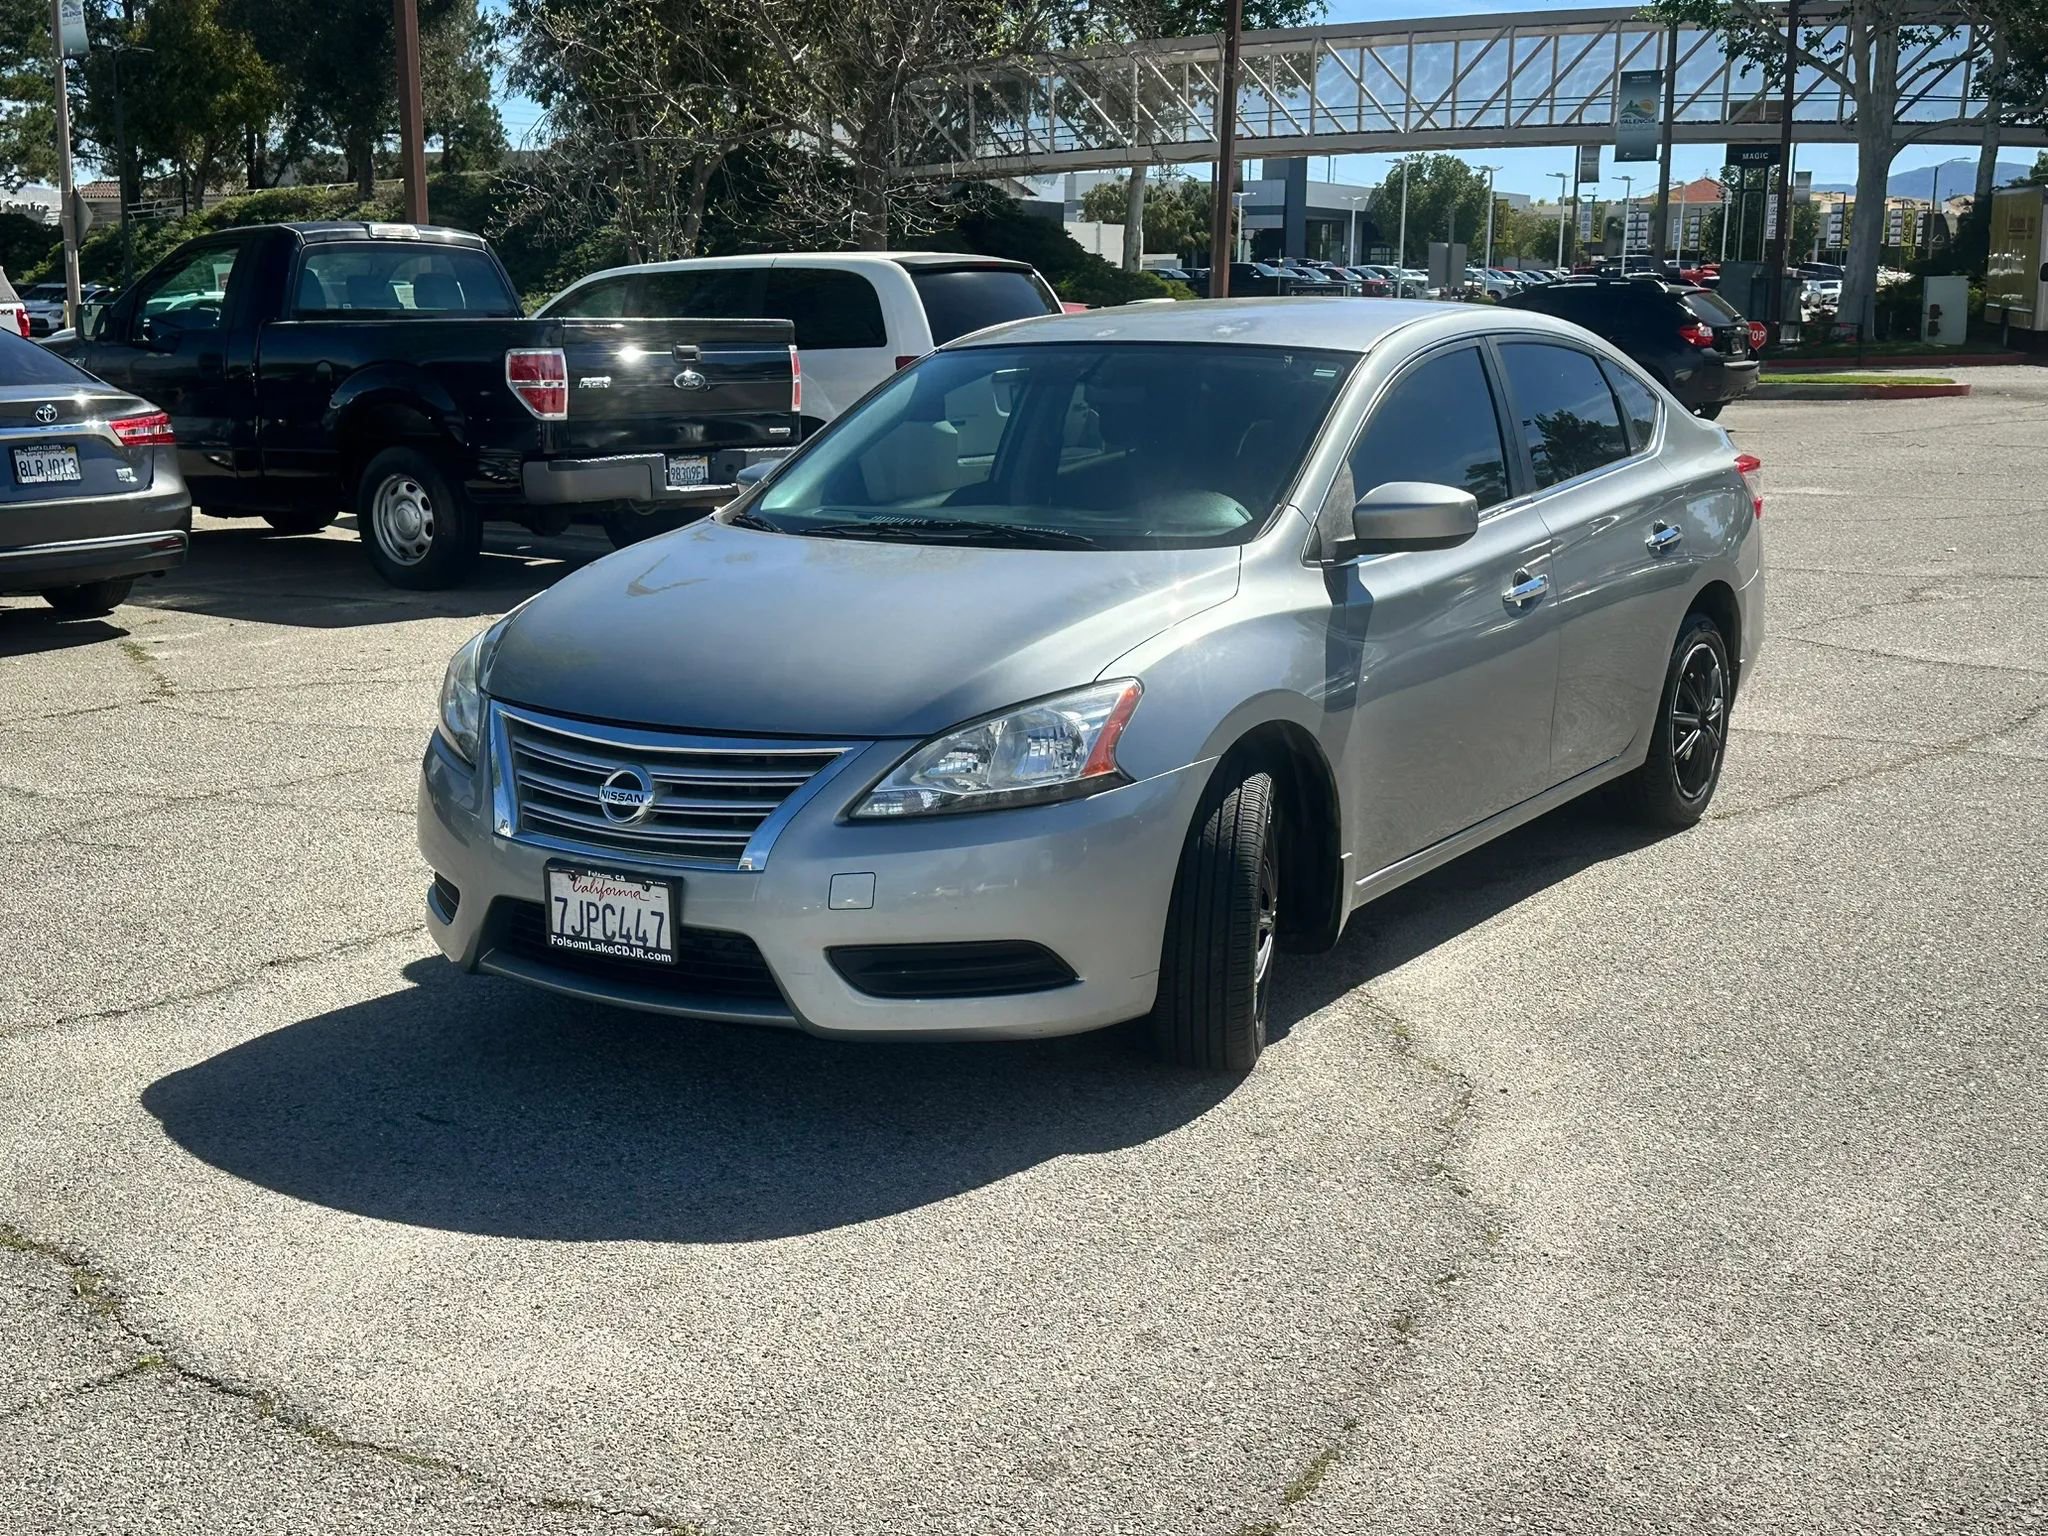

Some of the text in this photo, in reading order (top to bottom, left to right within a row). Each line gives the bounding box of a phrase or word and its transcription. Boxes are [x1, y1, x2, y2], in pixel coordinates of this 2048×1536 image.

[1742, 152, 1769, 160] MAGIC
[19, 457, 78, 476] 8LRJ013
[601, 789, 645, 803] NISSAN
[615, 874, 625, 882] CA
[572, 875, 650, 901] California
[554, 896, 664, 949] 7JPC447
[550, 935, 672, 962] FolsomLakeCDJR.com
